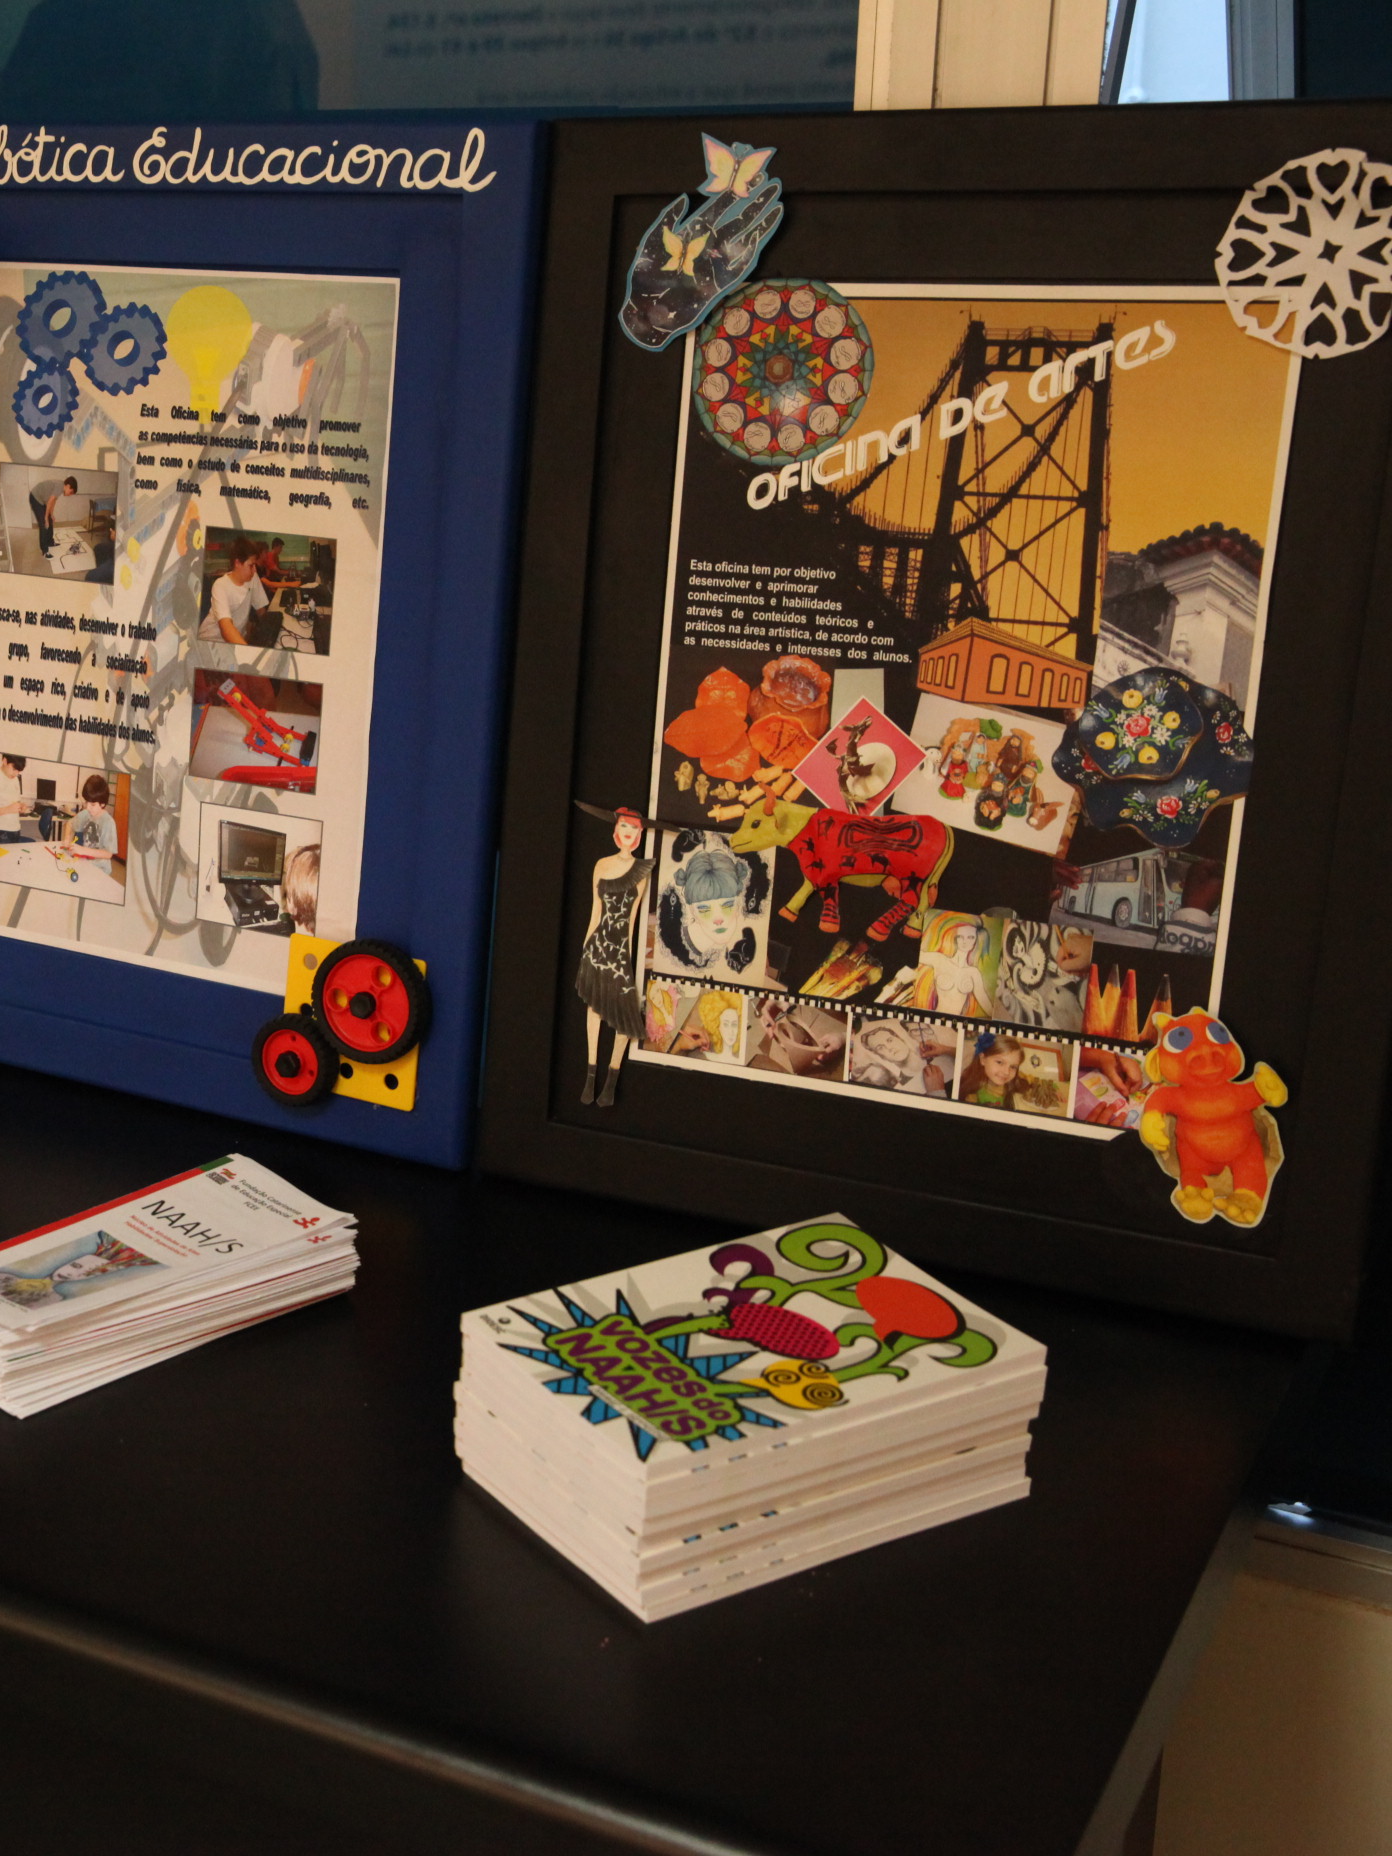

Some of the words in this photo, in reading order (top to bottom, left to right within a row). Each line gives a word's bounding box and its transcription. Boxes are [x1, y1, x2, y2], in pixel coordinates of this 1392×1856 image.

[132, 126, 497, 193] Educacional
[140, 404, 159, 418] Esta
[171, 406, 199, 421] Oficina
[211, 410, 226, 423] tem
[238, 414, 260, 425] como
[273, 414, 307, 430] objetivo
[319, 418, 361, 433] promover
[138, 431, 149, 441] as
[151, 430, 208, 447] competências
[210, 436, 258, 450] necessárias
[260, 440, 279, 454] para
[281, 442, 287, 451] o
[289, 442, 305, 452] uso
[308, 440, 318, 454] da
[321, 444, 369, 462] tecnologia,
[137, 452, 155, 466] bem
[160, 456, 183, 468] como
[187, 459, 193, 469] o
[198, 457, 225, 471] estudo
[230, 460, 241, 473] de
[245, 462, 285, 477] conceitos
[290, 465, 370, 487] multidisciplinares,
[134, 478, 158, 490] como
[220, 484, 271, 503] matemática,
[289, 491, 332, 510] geografia,
[352, 496, 369, 509] etc.
[689, 575, 750, 589] desenvolver
[756, 581, 762, 590] e
[767, 582, 818, 594] aprimorar
[690, 559, 712, 571] Esta
[715, 562, 749, 574] oficina
[752, 564, 771, 575] tem
[774, 567, 791, 578] por
[794, 566, 836, 579] objetivo
[688, 591, 765, 605] conhecimentos
[770, 597, 777, 606] e
[782, 596, 842, 611] habilidades
[25, 610, 37, 625] nas
[40, 609, 76, 634] atividades,
[79, 615, 119, 636] desenvolver
[121, 624, 125, 637] o
[128, 621, 157, 641] trabalho
[685, 621, 725, 633] práticos
[728, 625, 741, 634] na
[743, 624, 766, 635] área
[816, 629, 828, 641] de
[831, 631, 868, 644] acordo
[871, 636, 894, 646] com
[686, 606, 723, 617] através
[732, 608, 744, 619] de
[753, 610, 806, 624] conteúdos
[816, 615, 858, 628] teóricos
[867, 620, 874, 629] e
[8, 642, 29, 661] grupo,
[40, 642, 81, 664] favorecendo
[91, 653, 96, 666] a
[106, 653, 147, 678] socialização
[684, 637, 696, 645] as
[701, 638, 770, 651] necessidades
[776, 644, 782, 653] e
[788, 644, 841, 657] interesses
[847, 648, 867, 659] dos
[873, 649, 913, 663] alunos.
[3, 675, 14, 688] um
[20, 676, 44, 698] espaço
[51, 678, 66, 700] rico,
[73, 681, 98, 701] criativo
[105, 689, 109, 703] e
[116, 687, 124, 704] de
[131, 691, 150, 711] apoio
[2, 707, 6, 720] o
[8, 705, 63, 729] desenvolvimento
[65, 712, 77, 732] das
[79, 714, 117, 737] habilidades
[118, 722, 130, 739] dos
[132, 724, 155, 744] alunos.
[141, 1200, 244, 1254] NAAH/S
[555, 1332, 707, 1436] NAAH/S
